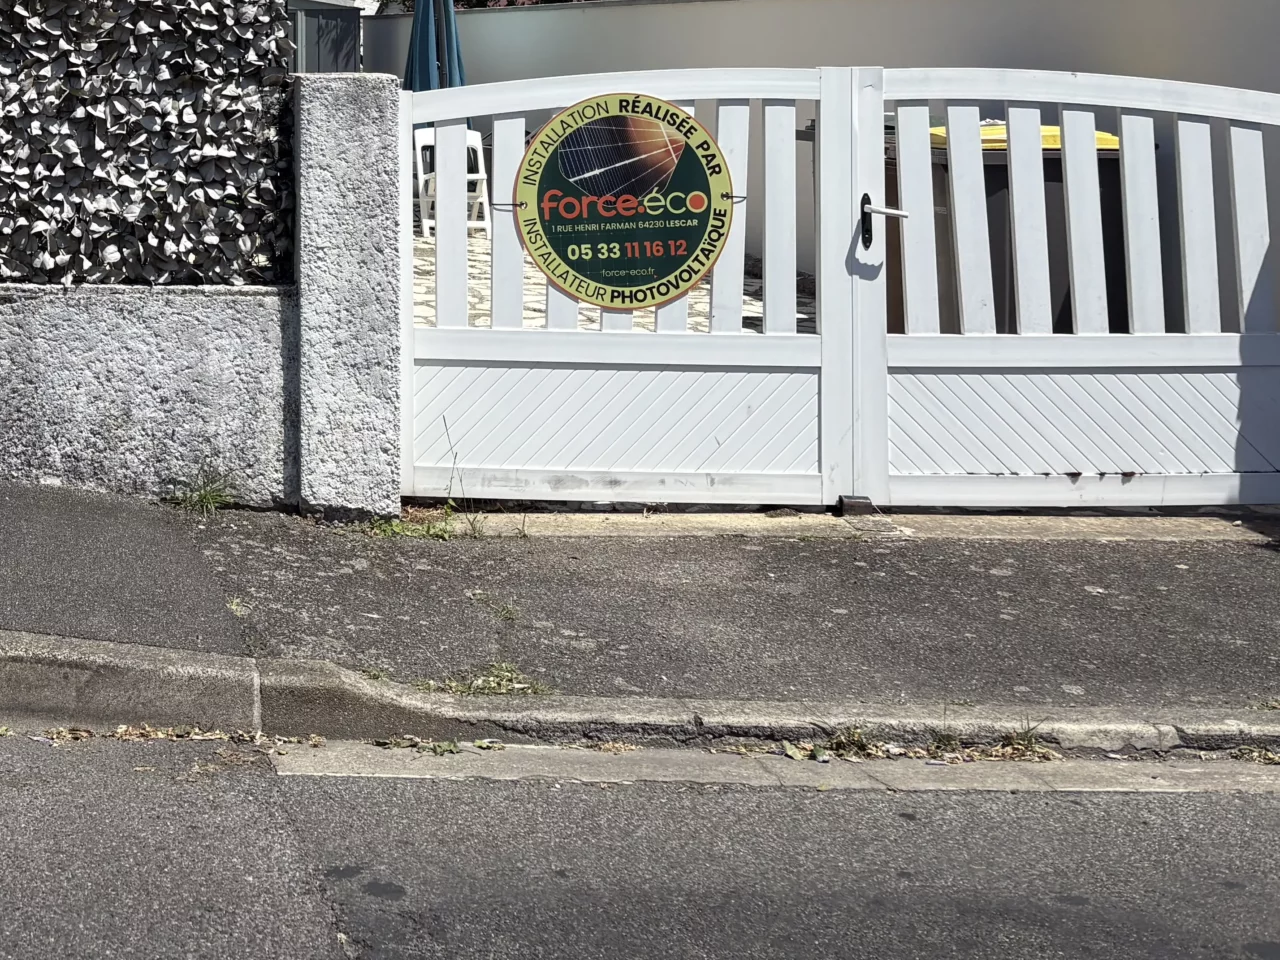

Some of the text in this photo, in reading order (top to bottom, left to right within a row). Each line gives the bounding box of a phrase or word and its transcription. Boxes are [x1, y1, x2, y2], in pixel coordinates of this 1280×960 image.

[522, 96, 723, 186] INSTALLATION RÉALISÉE PAR
[551, 219, 699, 233] 1 RUE HENRI FARMAN 64230 LESCAR
[523, 207, 728, 305] INSTALLATEUR PHOTOVOLTAÏQUE
[567, 239, 688, 261] 05 33 11 16 12
[602, 266, 656, 278] force-eco.fr
